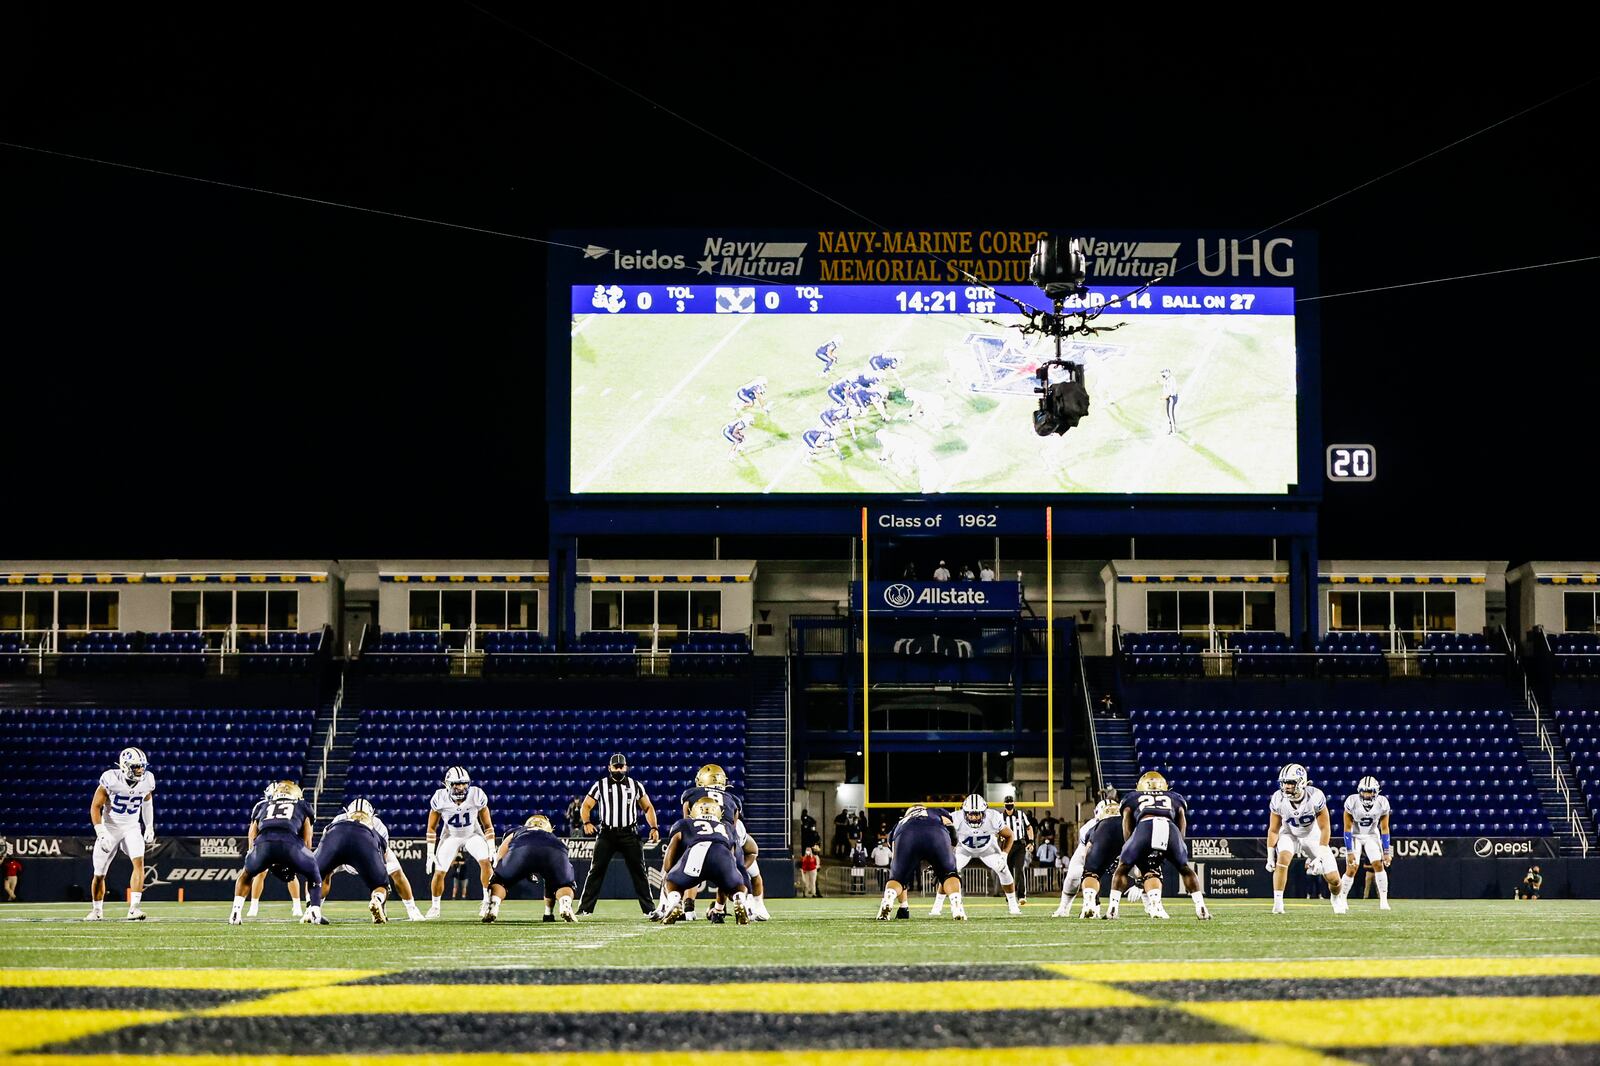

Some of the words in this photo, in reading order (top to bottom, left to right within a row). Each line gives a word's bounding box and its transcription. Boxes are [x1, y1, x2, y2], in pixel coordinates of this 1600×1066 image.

[703, 238, 763, 260] Navy
[818, 231, 972, 254] NAVY-MARINE
[1079, 237, 1137, 260] Navy
[614, 249, 686, 270] leidos
[1197, 238, 1295, 277] UHG
[720, 257, 804, 276] Mutual
[820, 259, 941, 281] MEMORIAL
[947, 259, 1031, 281] STADIU
[1094, 257, 1178, 277] Mutual
[637, 292, 652, 310] 0
[666, 287, 695, 299] TOL
[764, 292, 780, 309] 0
[795, 287, 823, 299] TOL
[896, 291, 956, 311] 14:21
[965, 287, 995, 299] QTR
[1127, 292, 1152, 309] 14
[676, 300, 685, 312] 3
[809, 300, 819, 312] 3
[967, 301, 995, 313] 1ST
[1162, 295, 1202, 309] BALL
[1203, 295, 1226, 309] ON
[1230, 293, 1256, 310] 27
[1334, 449, 1369, 477] 20
[878, 514, 922, 527] Class
[924, 514, 943, 527] of
[957, 514, 997, 527] 1962
[111, 794, 144, 815] 53
[1138, 795, 1172, 812] 23
[263, 803, 295, 821] 13
[447, 812, 473, 828] 41
[15, 839, 62, 855] USAA
[200, 838, 227, 847] NAVY
[961, 834, 991, 849] 47
[1192, 839, 1218, 848] NAVY
[1396, 840, 1443, 856] USAA
[1494, 840, 1531, 855] pepsi
[200, 846, 240, 855] FEDERAL
[1192, 847, 1232, 855] FEDERAL
[166, 868, 245, 881] BOEIN
[1210, 868, 1255, 877] Huntington
[1210, 877, 1236, 886] Ingalls
[1210, 886, 1249, 895] Industries
